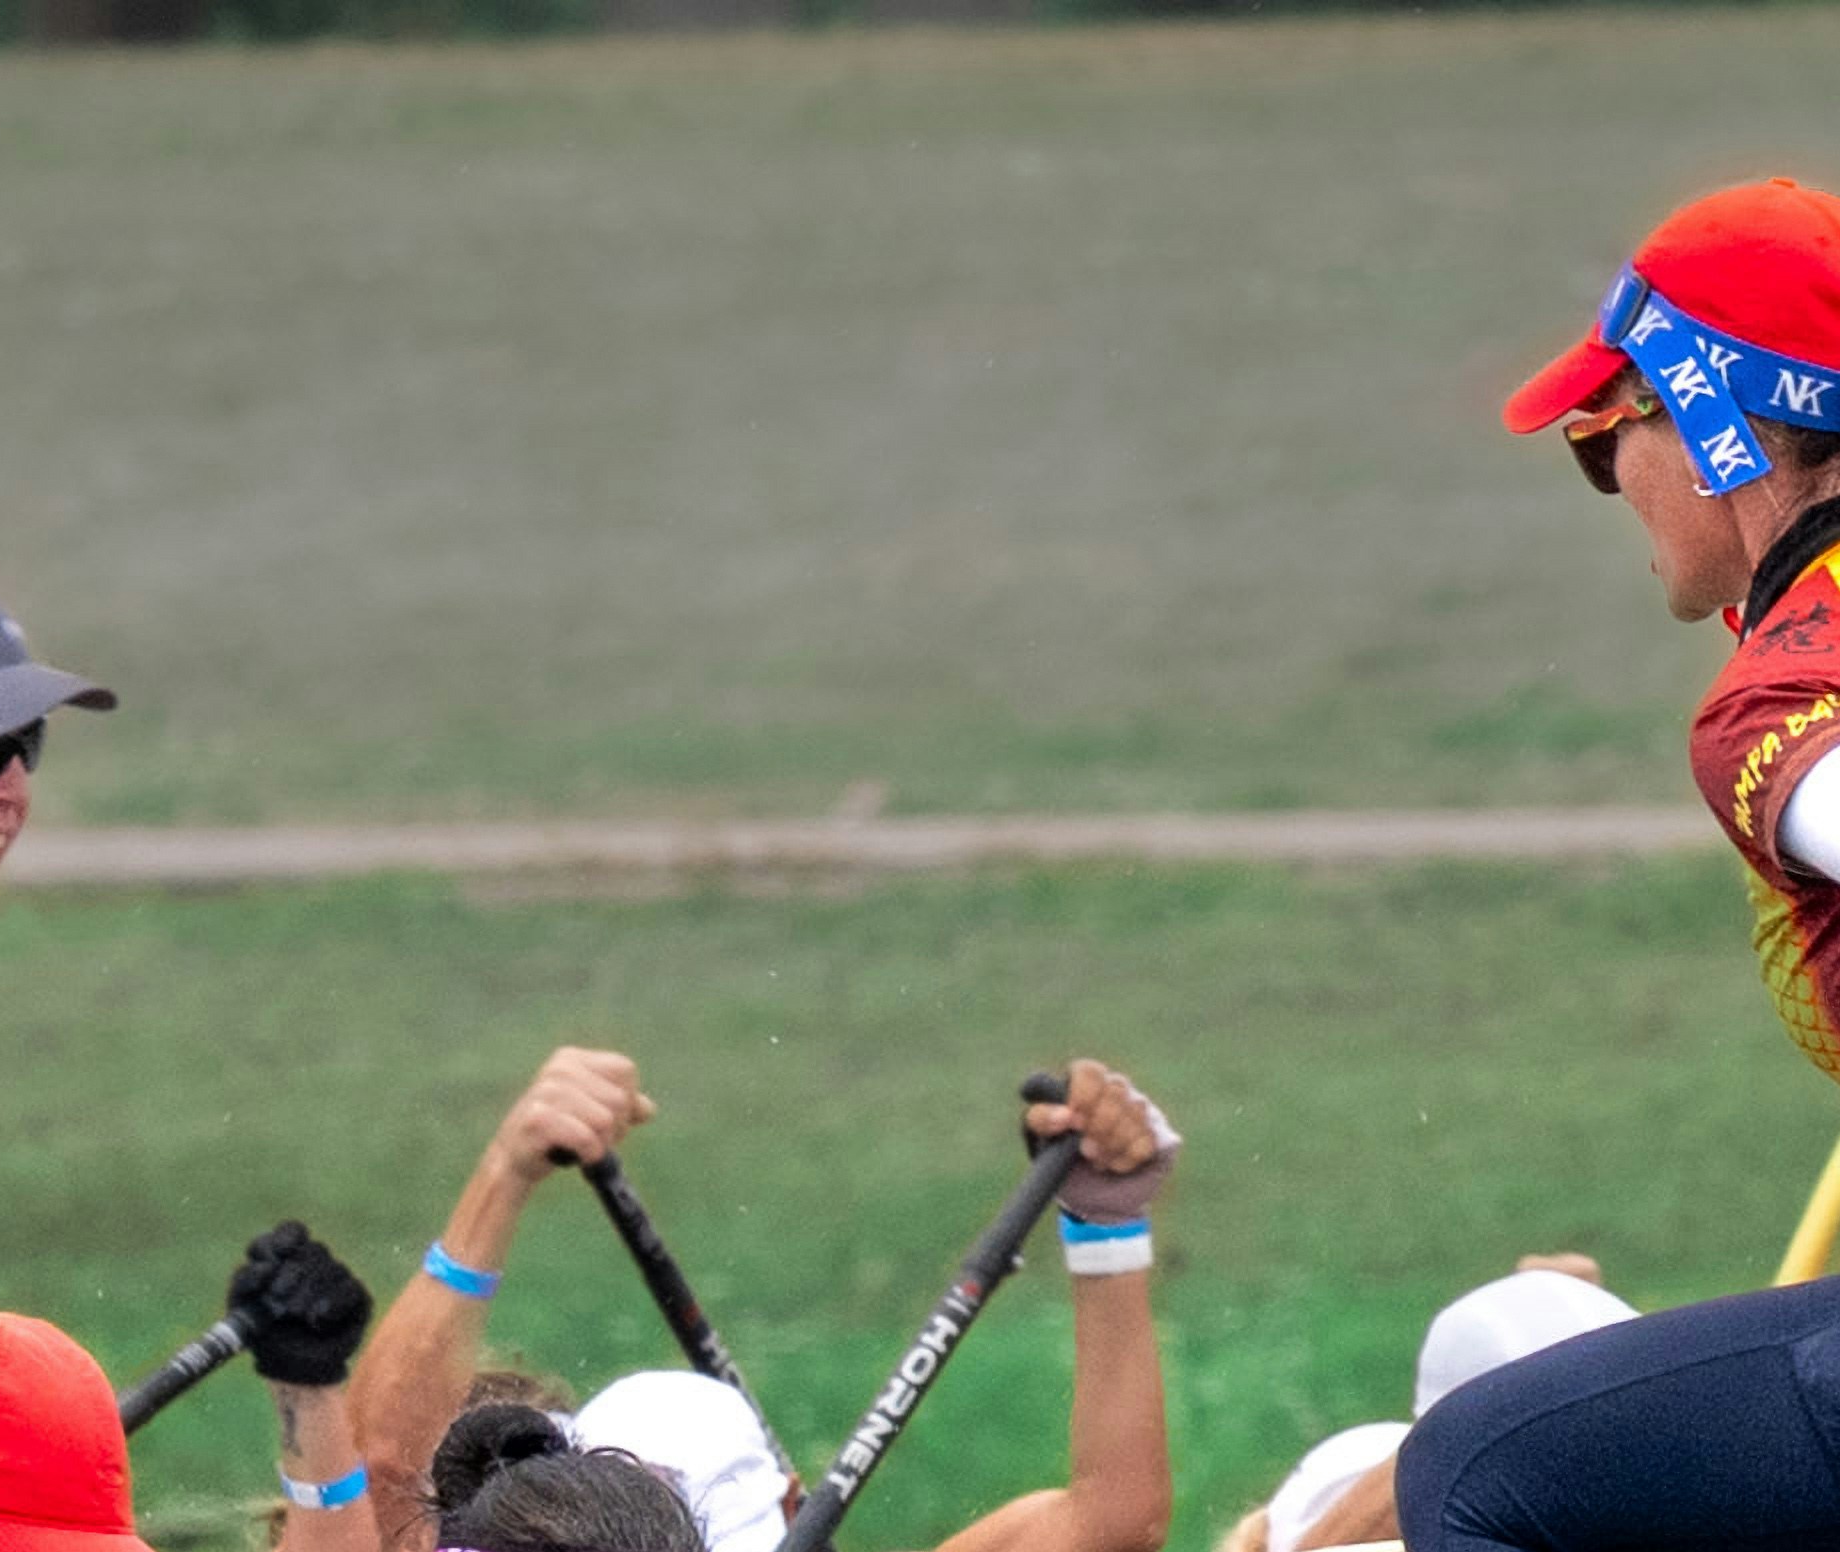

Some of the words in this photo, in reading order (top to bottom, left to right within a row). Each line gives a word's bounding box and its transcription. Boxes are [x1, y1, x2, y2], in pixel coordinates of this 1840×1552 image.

[1659, 355, 1717, 412] NK
[1768, 367, 1835, 417] NK
[1700, 424, 1757, 484] NK
[827, 1314, 960, 1503] HORNET
